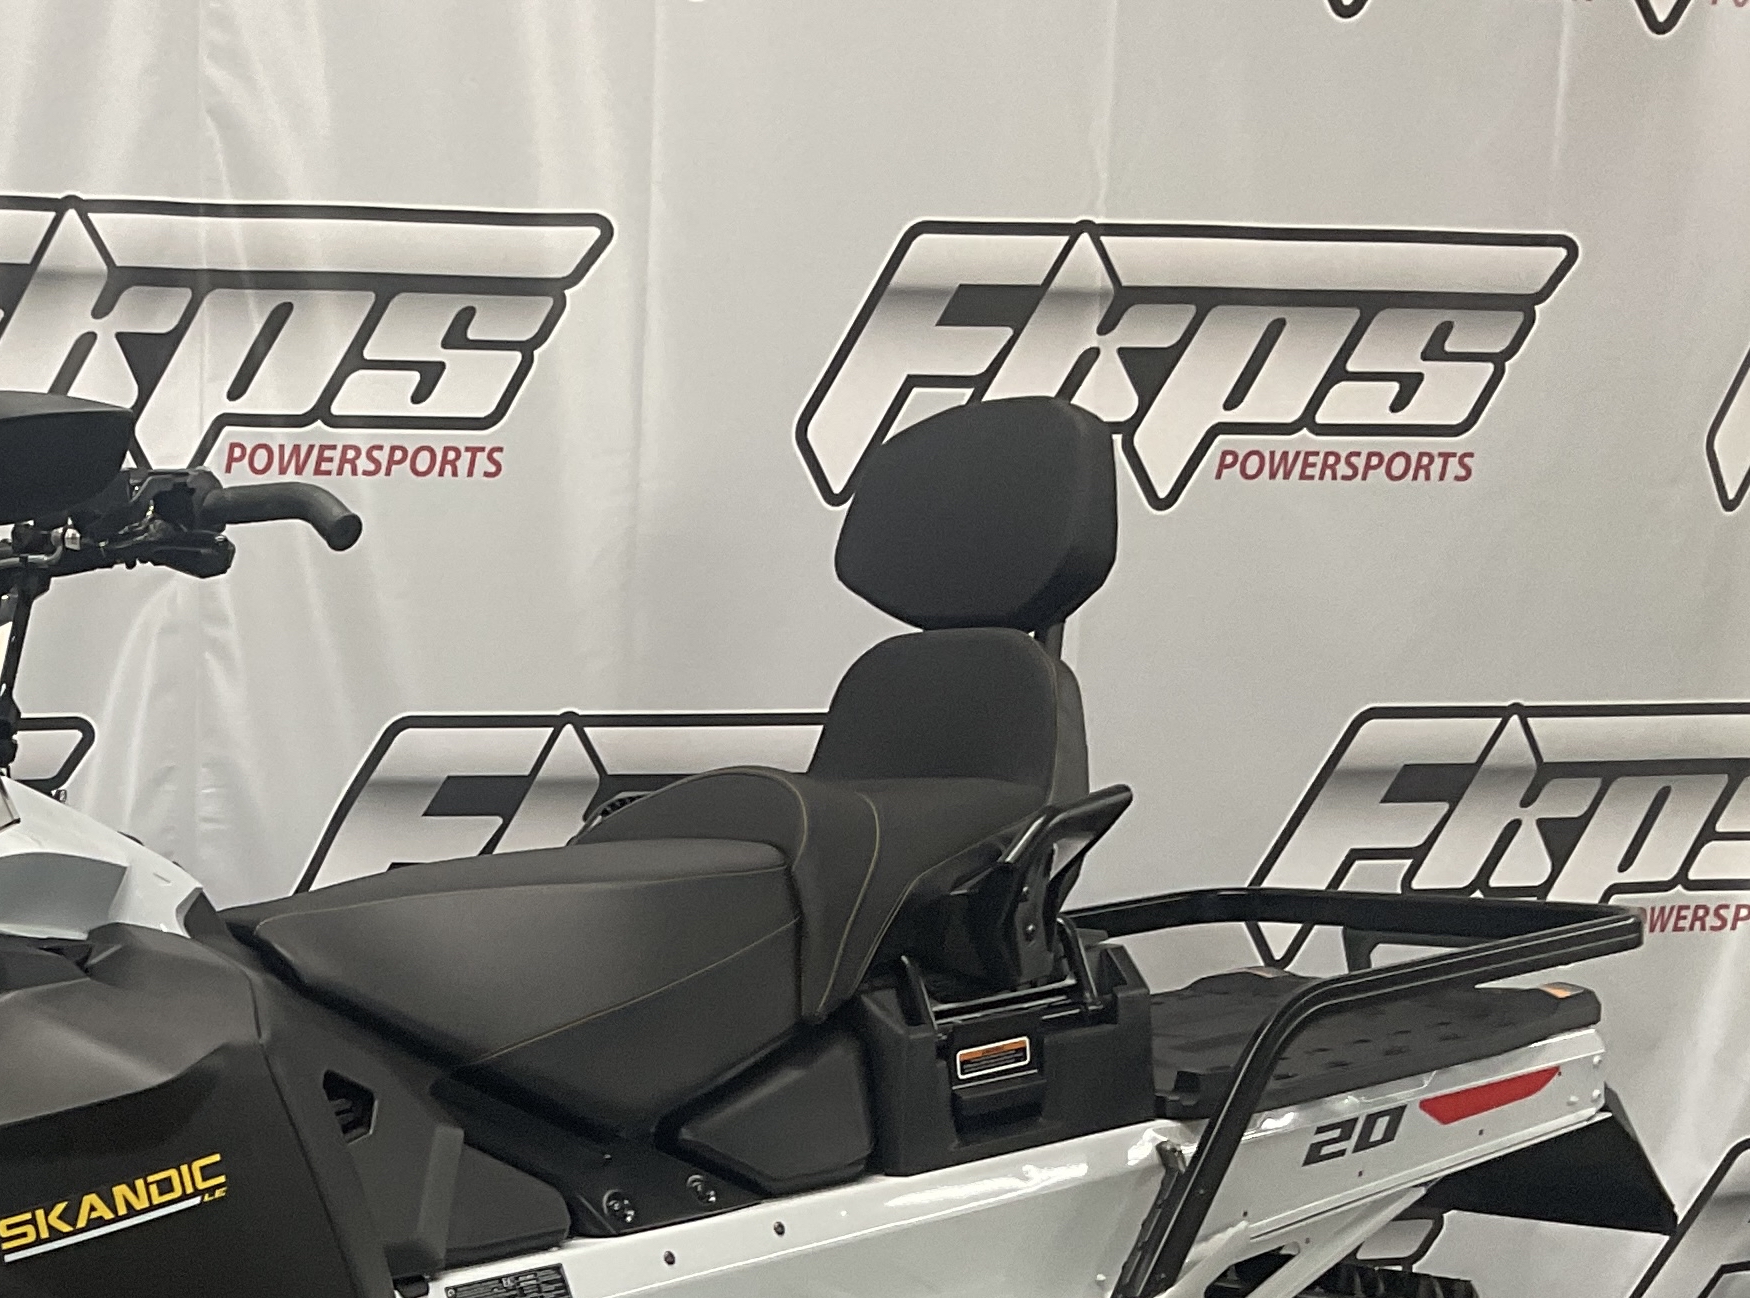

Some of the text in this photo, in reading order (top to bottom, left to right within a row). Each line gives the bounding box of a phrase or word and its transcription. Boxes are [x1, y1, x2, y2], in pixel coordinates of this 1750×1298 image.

[224, 441, 504, 480] POWERSPORTS
[1214, 448, 1475, 482] POWERSPORTS
[1301, 1103, 1408, 1168] 20
[202, 1186, 228, 1202] LE
